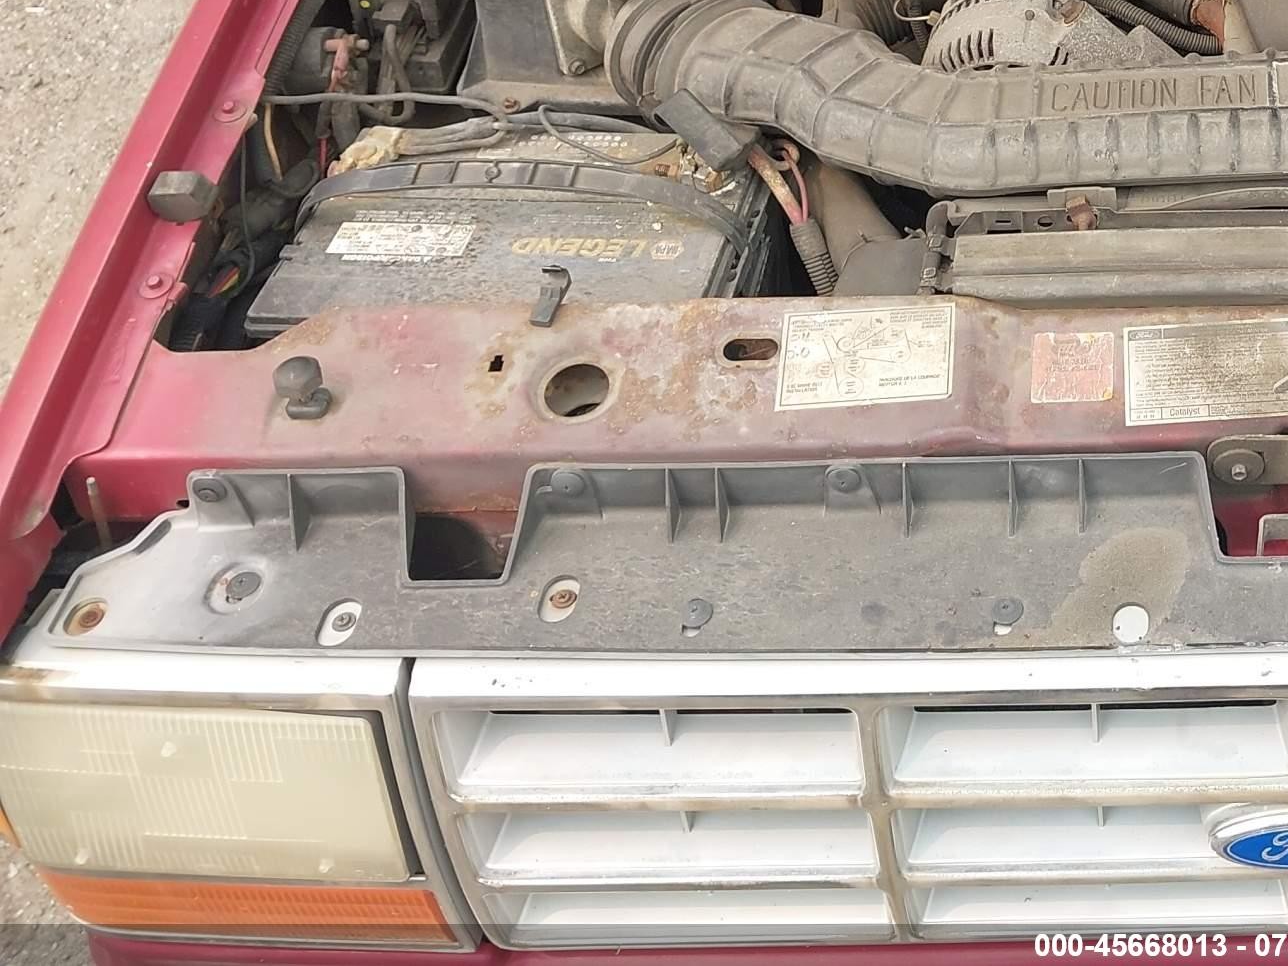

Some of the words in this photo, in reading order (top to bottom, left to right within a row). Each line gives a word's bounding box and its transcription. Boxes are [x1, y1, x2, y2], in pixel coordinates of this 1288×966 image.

[1051, 77, 1178, 113] CAUTION
[1199, 73, 1257, 106] FAN
[511, 237, 649, 257] LEGEND
[1169, 407, 1200, 417] Catalyst
